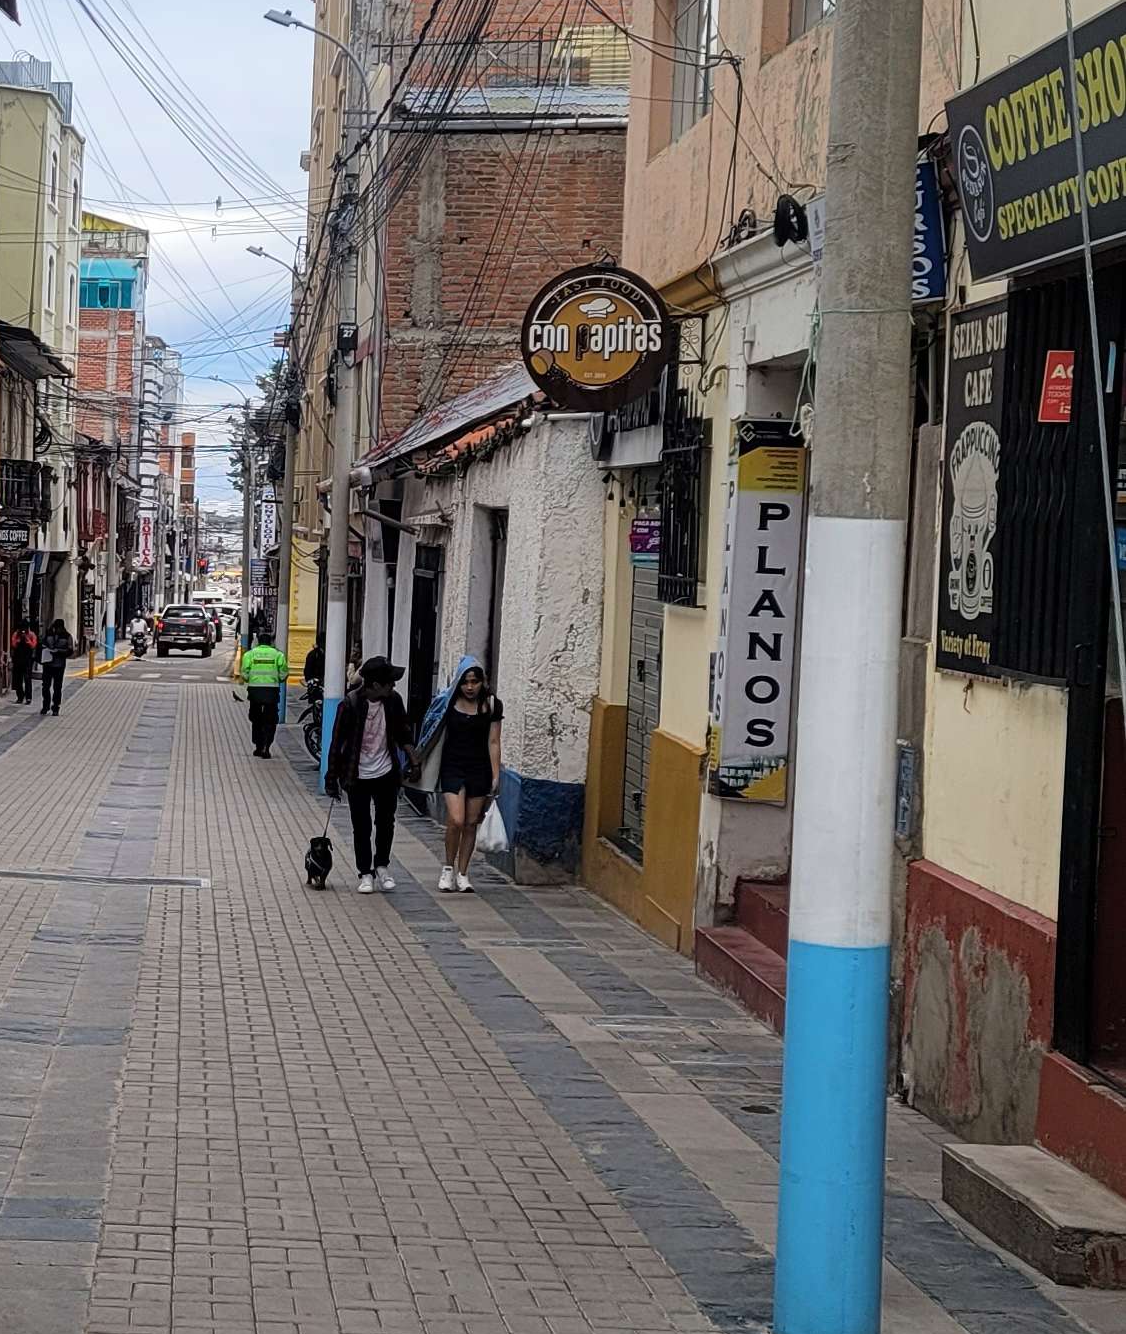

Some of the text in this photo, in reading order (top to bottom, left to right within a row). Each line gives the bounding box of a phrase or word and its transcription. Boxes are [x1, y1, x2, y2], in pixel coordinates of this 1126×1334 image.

[985, 34, 1126, 171] COFFEE SHO
[997, 175, 1082, 240] SPECIALTY
[554, 278, 640, 303] FAST FOOD
[529, 315, 662, 361] con papitas
[954, 319, 984, 360] SELVA
[964, 355, 993, 407] CAFÉ
[142, 517, 152, 565] BOTICA
[715, 481, 735, 722] PLANOS
[744, 502, 791, 747] PLANOS
[941, 630, 964, 660] Variety
